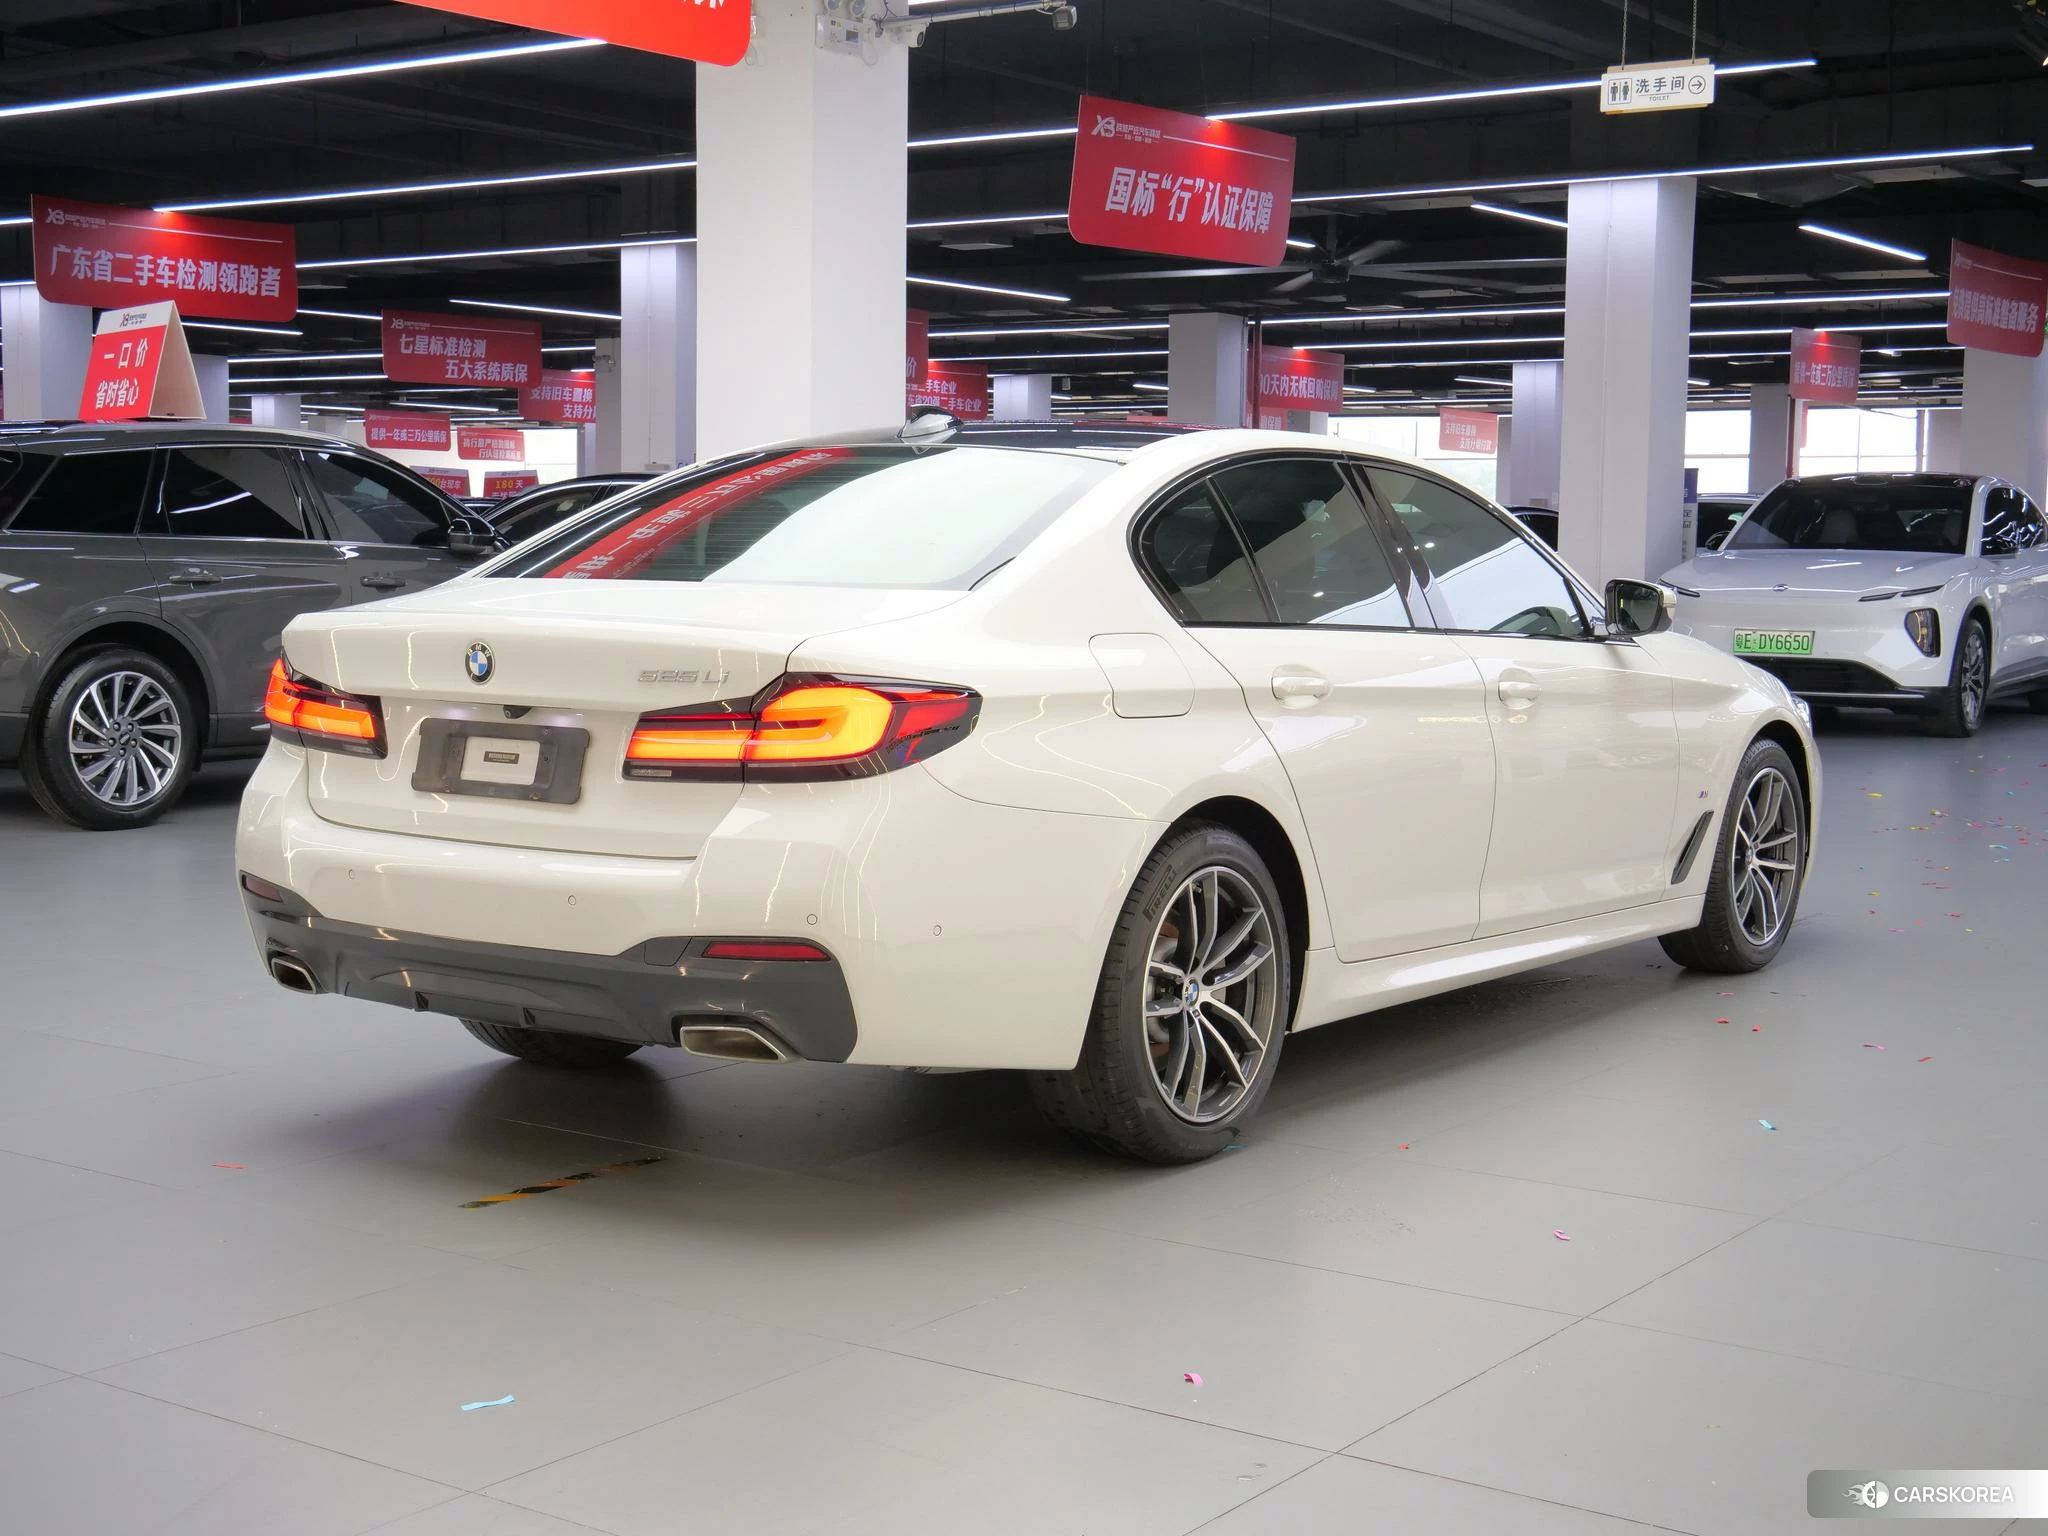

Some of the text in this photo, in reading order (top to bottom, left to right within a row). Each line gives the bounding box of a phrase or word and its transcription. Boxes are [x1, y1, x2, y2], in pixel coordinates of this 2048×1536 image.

[1636, 76, 1685, 93] 洗手间
[1105, 166, 1274, 234] 国标“行”认证保障
[50, 244, 281, 298] 广东省二手车检测领跑者
[104, 338, 148, 368] 一口价
[399, 334, 487, 358] 七星标准检测
[445, 360, 528, 383] 五大系统质保
[95, 378, 139, 409] 省时省心
[529, 385, 593, 403] 支持旧车置换
[1260, 374, 1340, 401] 0天内无忧回购保障
[562, 404, 597, 420] 支持分
[495, 477, 523, 488] 180 天
